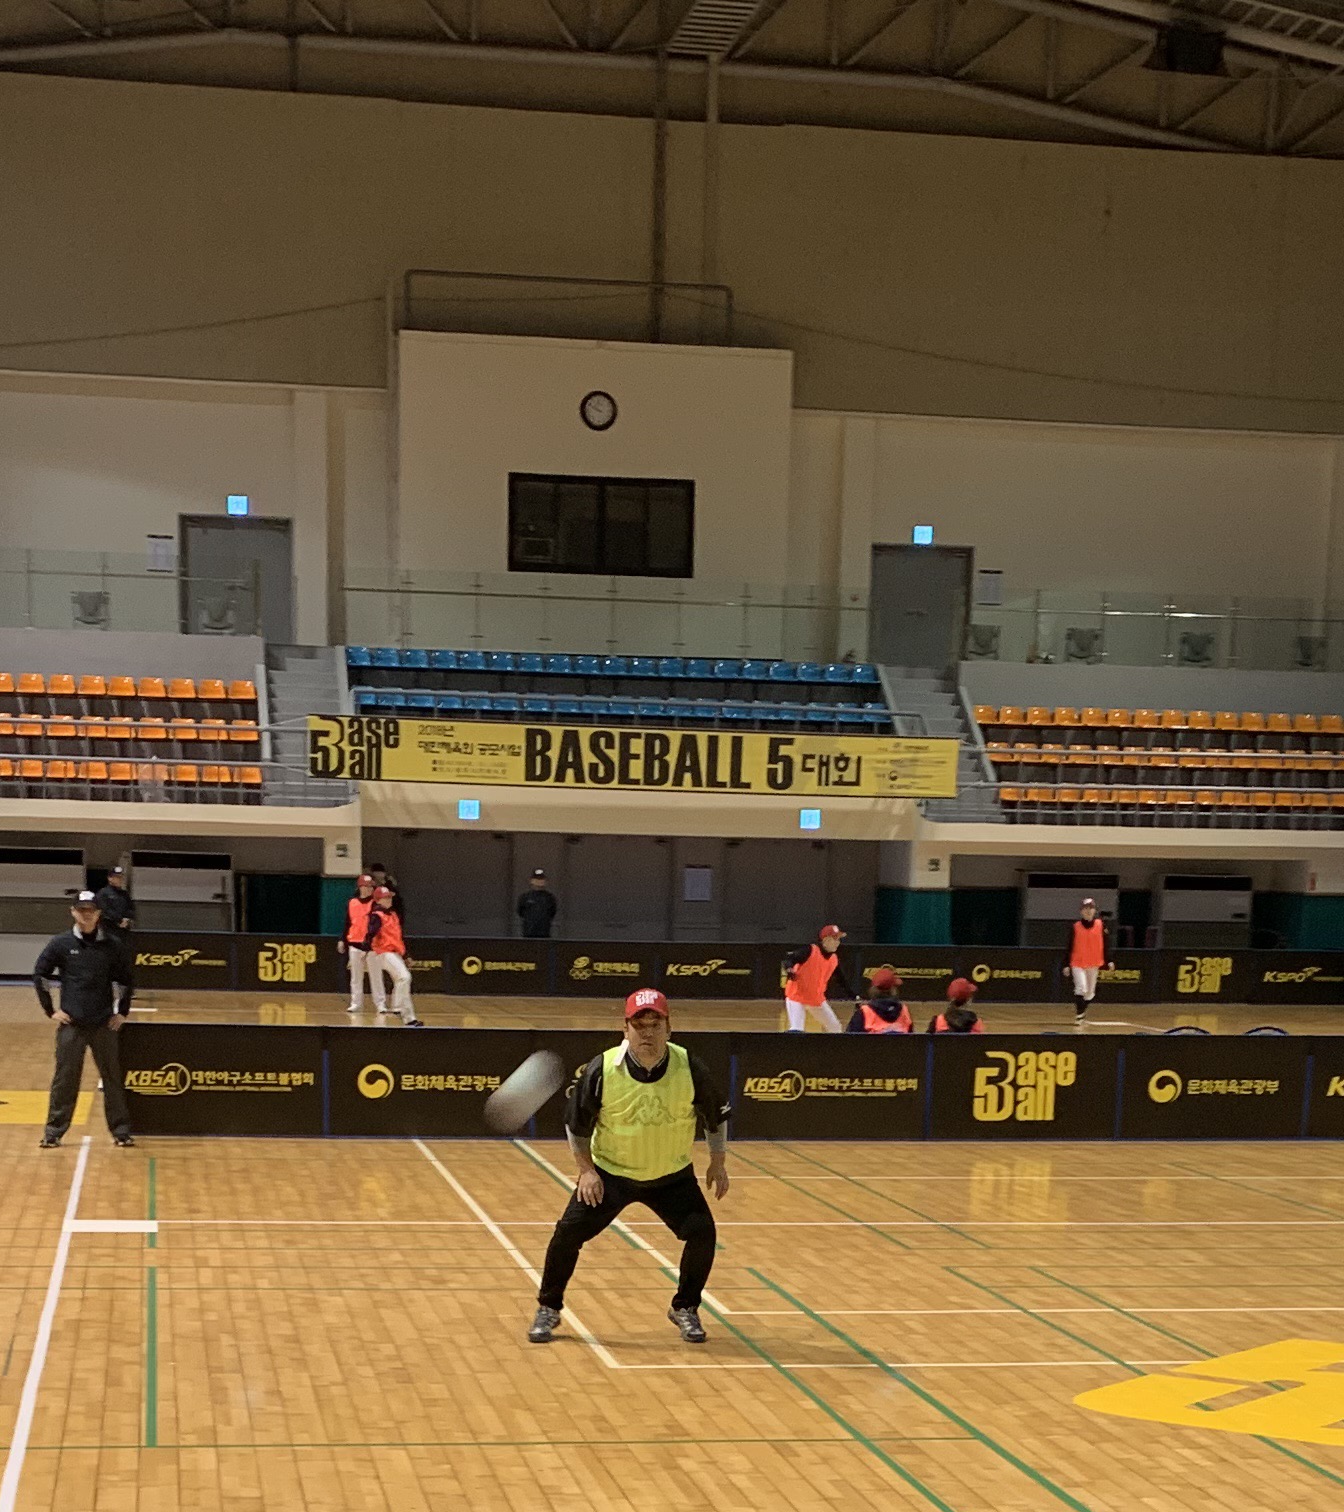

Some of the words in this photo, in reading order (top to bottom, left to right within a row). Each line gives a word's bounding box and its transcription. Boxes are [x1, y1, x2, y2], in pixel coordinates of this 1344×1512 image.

[525, 727, 752, 790] BASEBALL
[767, 737, 796, 791] 5
[801, 753, 862, 787] 대회
[135, 953, 183, 967] KSPO
[666, 963, 710, 976] KSPO
[124, 1070, 177, 1087] KBSA
[743, 1077, 792, 1093] KBSA
